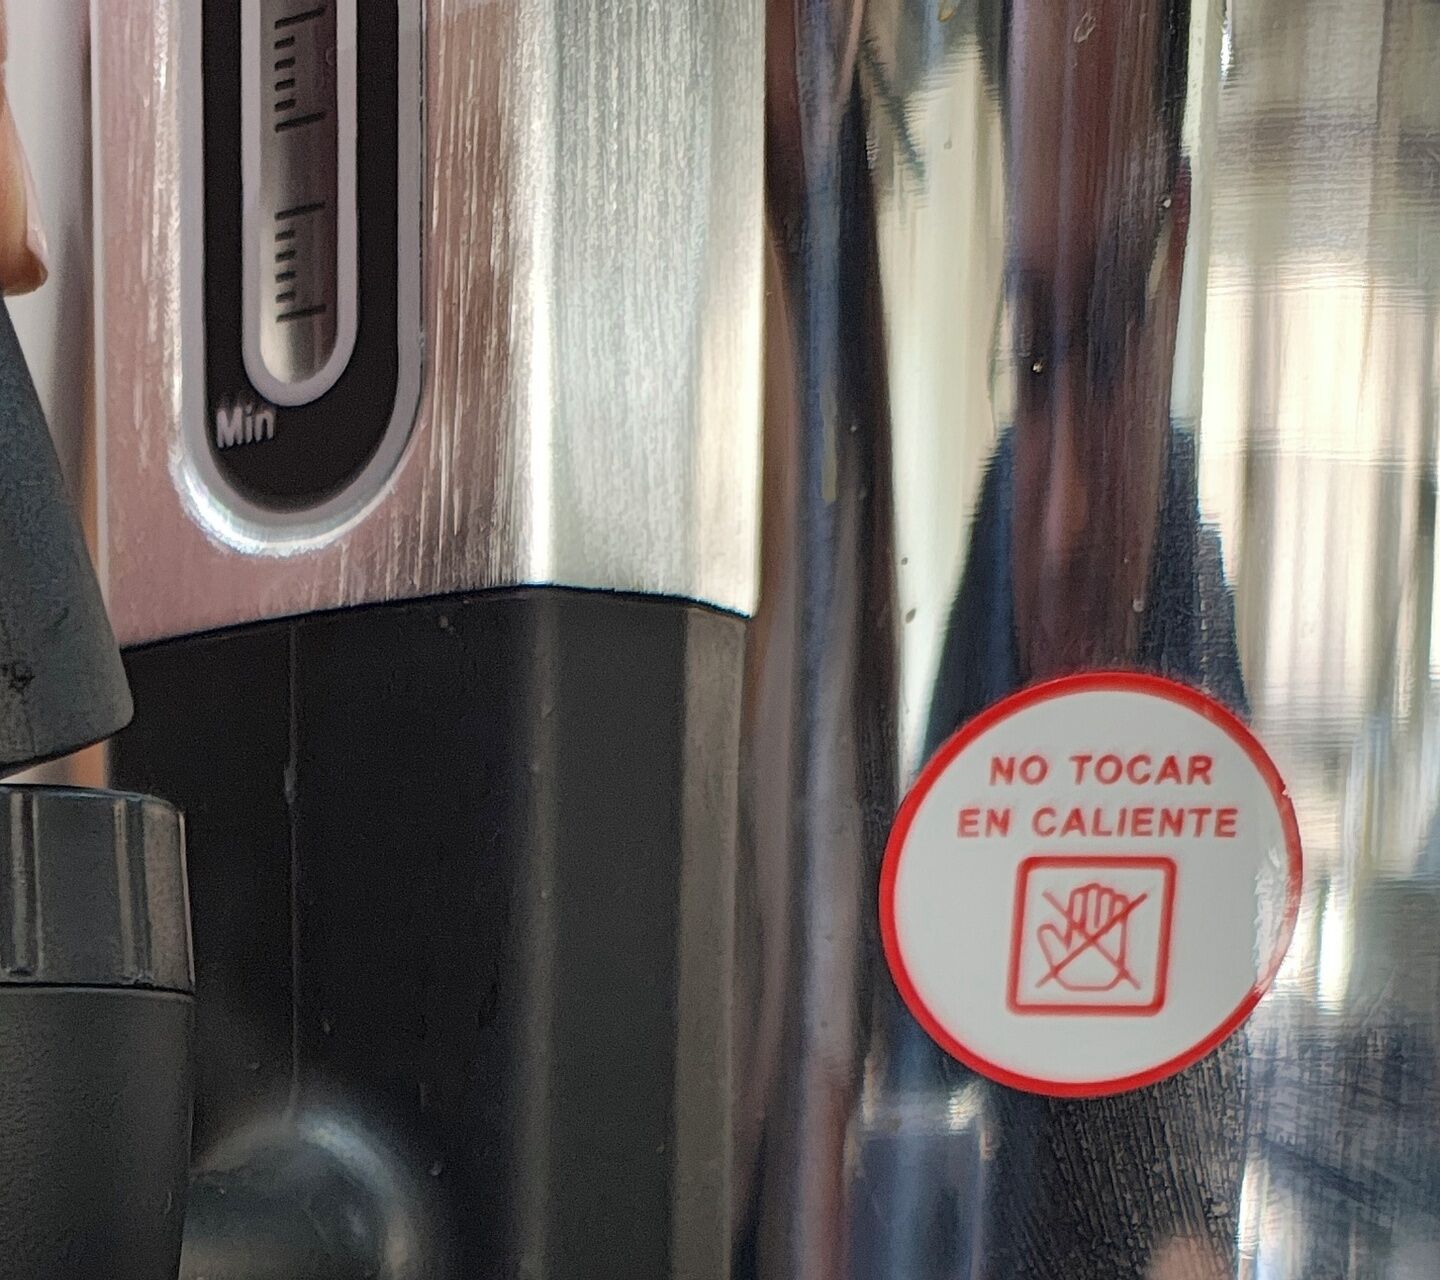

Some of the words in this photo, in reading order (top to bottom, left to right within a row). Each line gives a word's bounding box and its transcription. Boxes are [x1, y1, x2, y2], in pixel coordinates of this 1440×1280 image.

[216, 404, 275, 449] Min
[989, 754, 1048, 785] NO
[1070, 754, 1213, 785] TOCAR
[957, 807, 1011, 838] EN
[1031, 806, 1239, 838] CALIENTE
